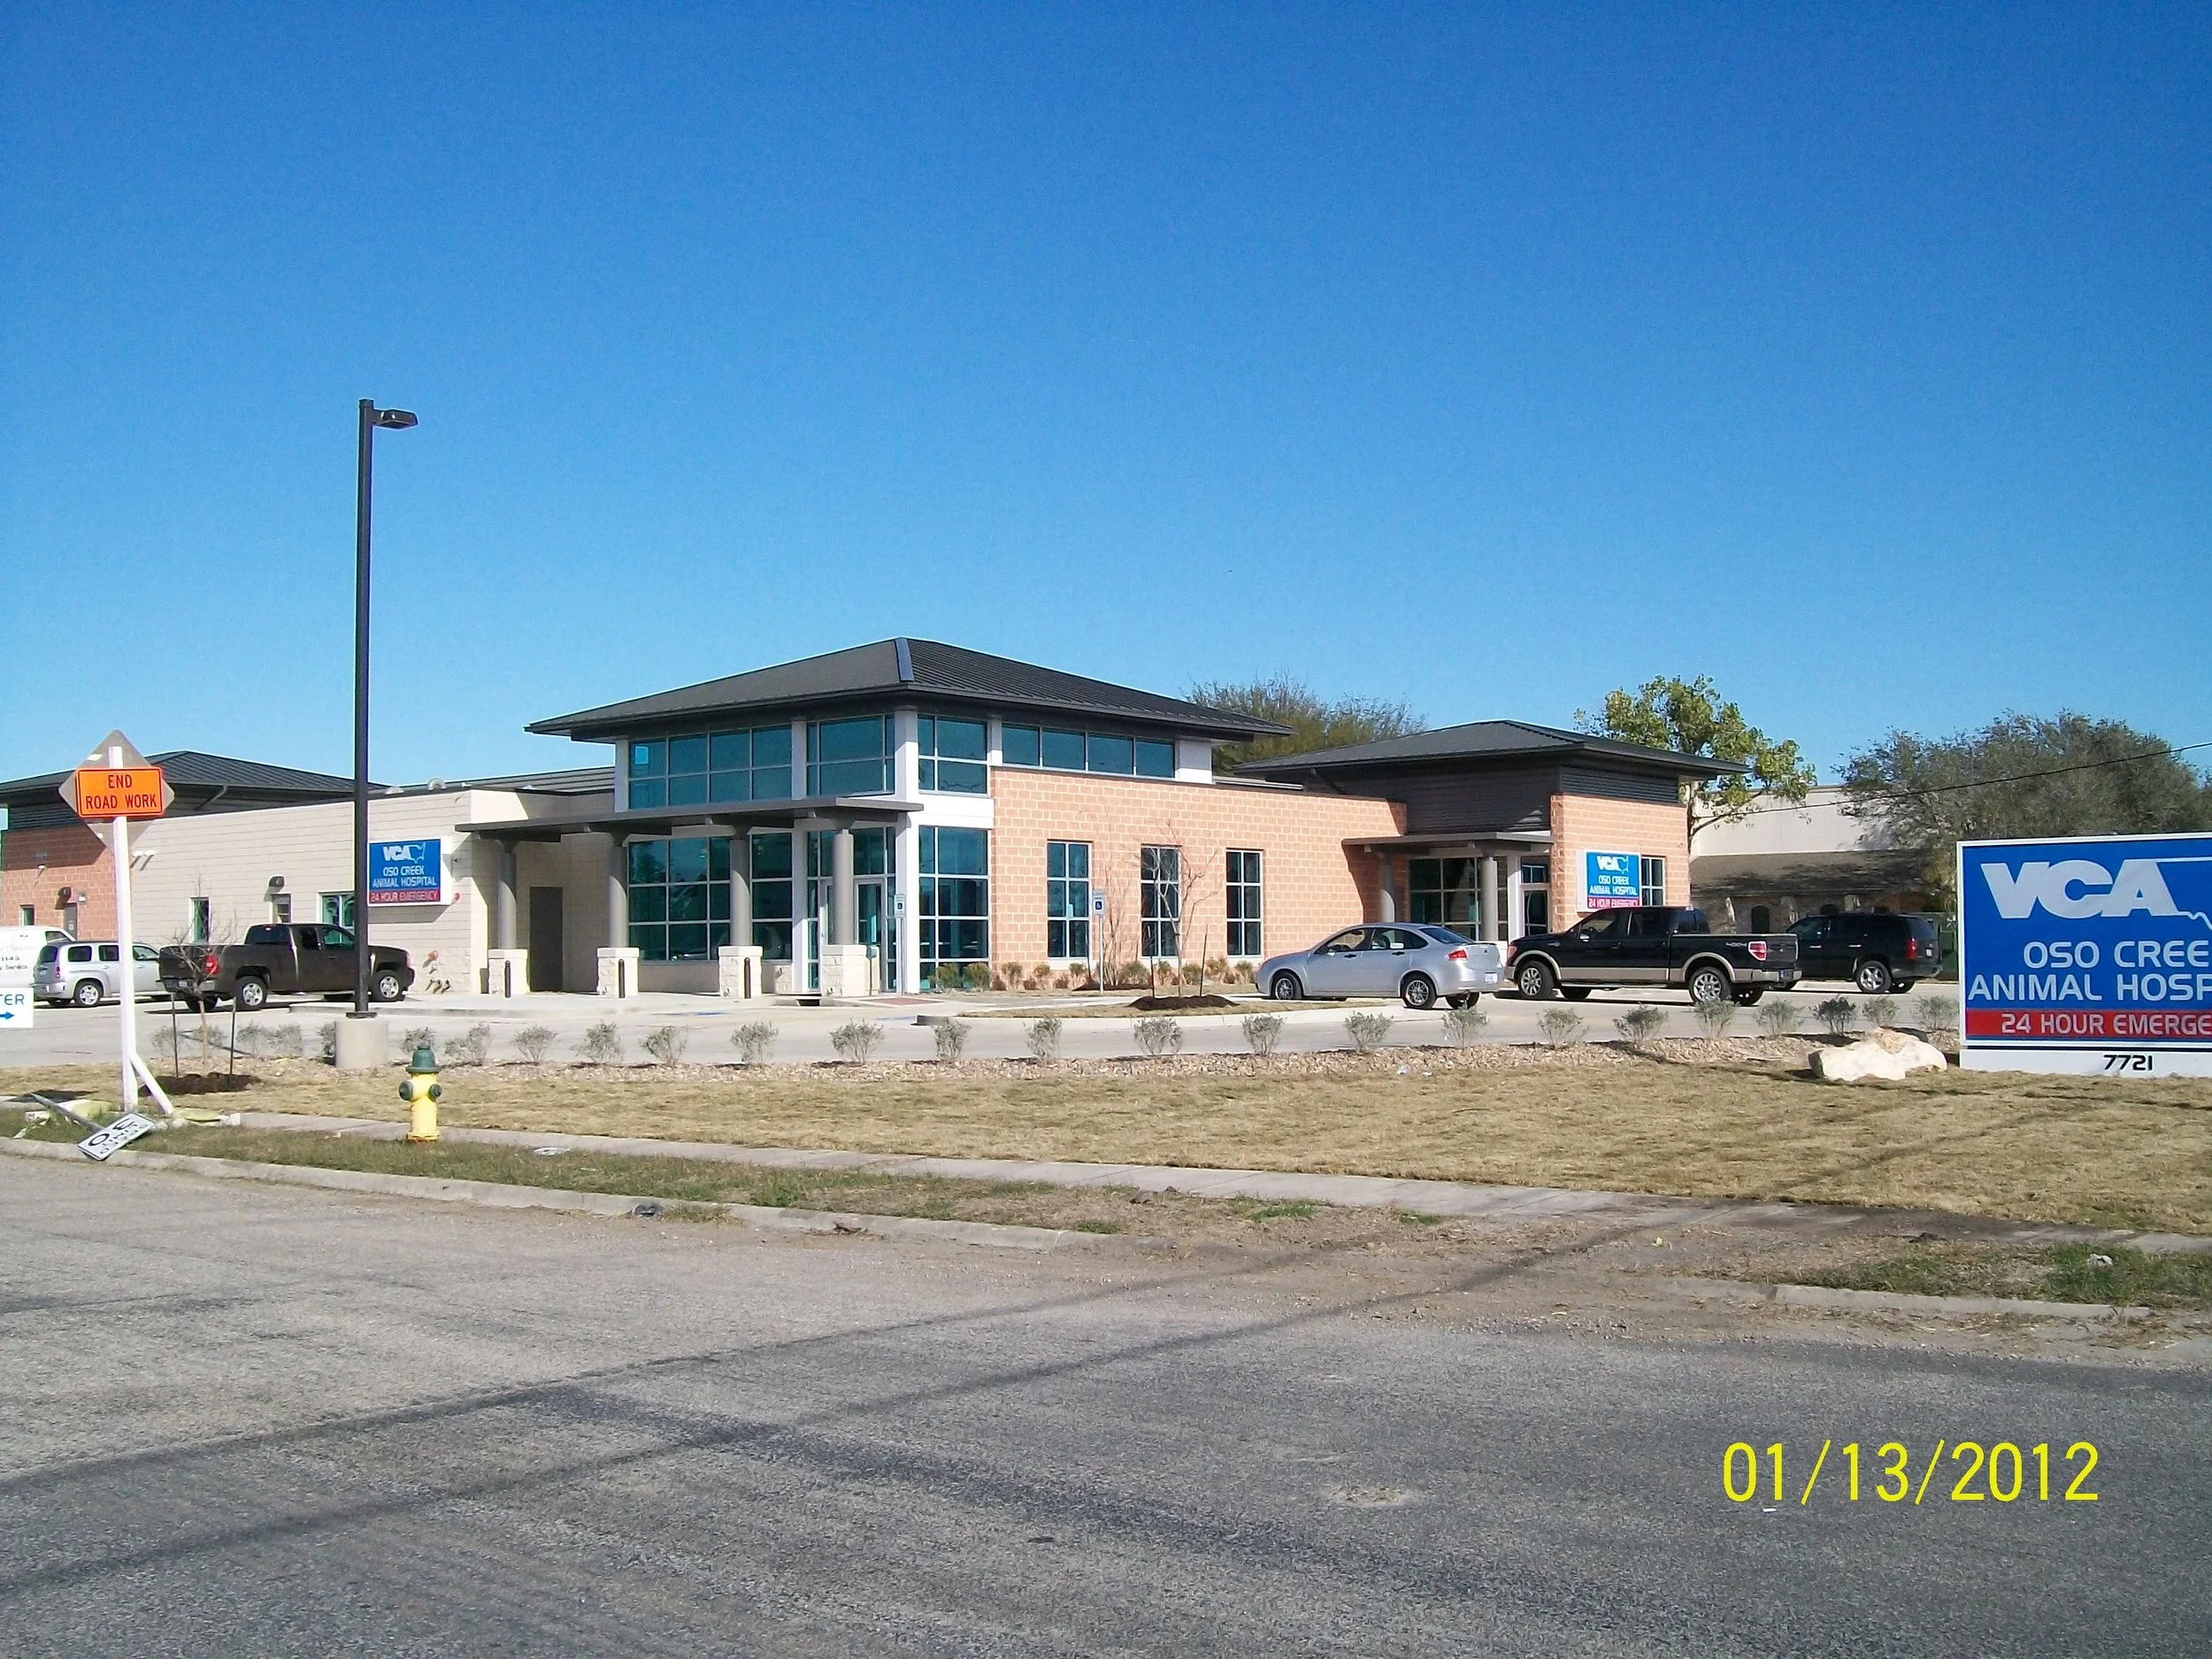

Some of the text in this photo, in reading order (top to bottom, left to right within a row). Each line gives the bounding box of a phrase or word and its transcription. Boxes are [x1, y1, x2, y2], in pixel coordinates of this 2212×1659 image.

[108, 774, 133, 789] END
[86, 794, 157, 810] ROAD WORK
[383, 845, 411, 861] VCA
[383, 865, 425, 877] OSO CREEK
[373, 877, 437, 887] ANIMAL HOSPITAL
[1611, 875, 1630, 886] CREEK
[370, 890, 437, 902] 24 HOUR EMERGENCY
[1589, 885, 1639, 896] ANIMAL HOSPITAL
[1980, 859, 2177, 919] VCA
[1588, 898, 1596, 908] 24
[1596, 898, 1610, 908] HOUR
[2023, 940, 2210, 969] OSO CREE
[1968, 973, 2102, 1002] ANIMAL
[0, 994, 25, 1006] ER
[2001, 1013, 2032, 1034] 24
[2040, 1013, 2105, 1034] HOUR
[2102, 1054, 2154, 1071] 7721
[88, 1118, 134, 1147] 30
